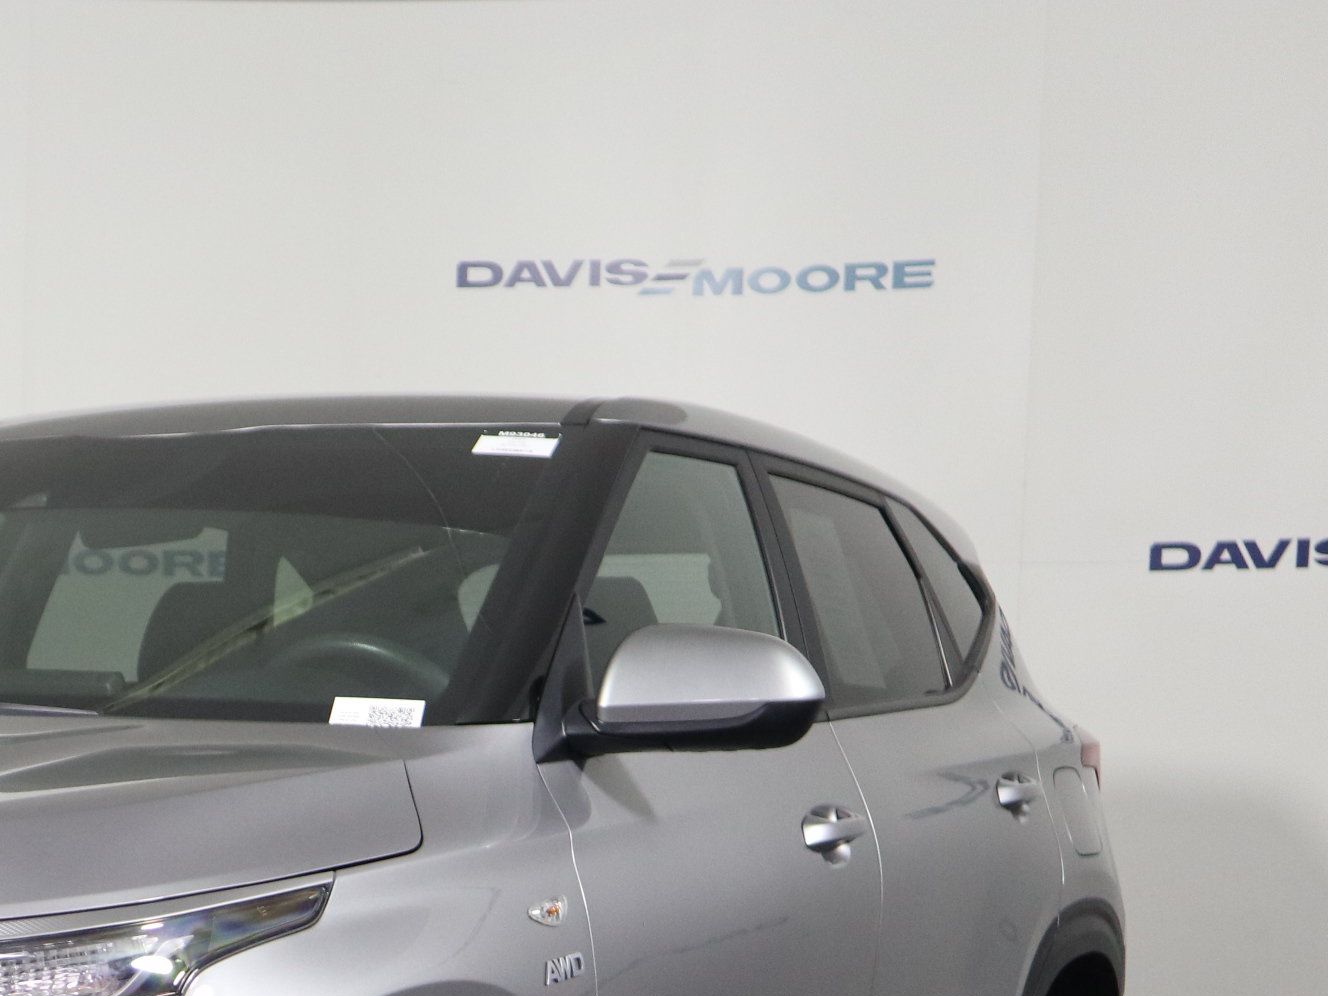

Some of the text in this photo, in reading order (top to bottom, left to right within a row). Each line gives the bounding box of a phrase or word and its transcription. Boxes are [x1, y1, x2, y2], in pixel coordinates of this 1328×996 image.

[455, 258, 936, 297] DAVIS MOORE
[63, 549, 225, 577] OOR
[544, 951, 585, 986] AWD
